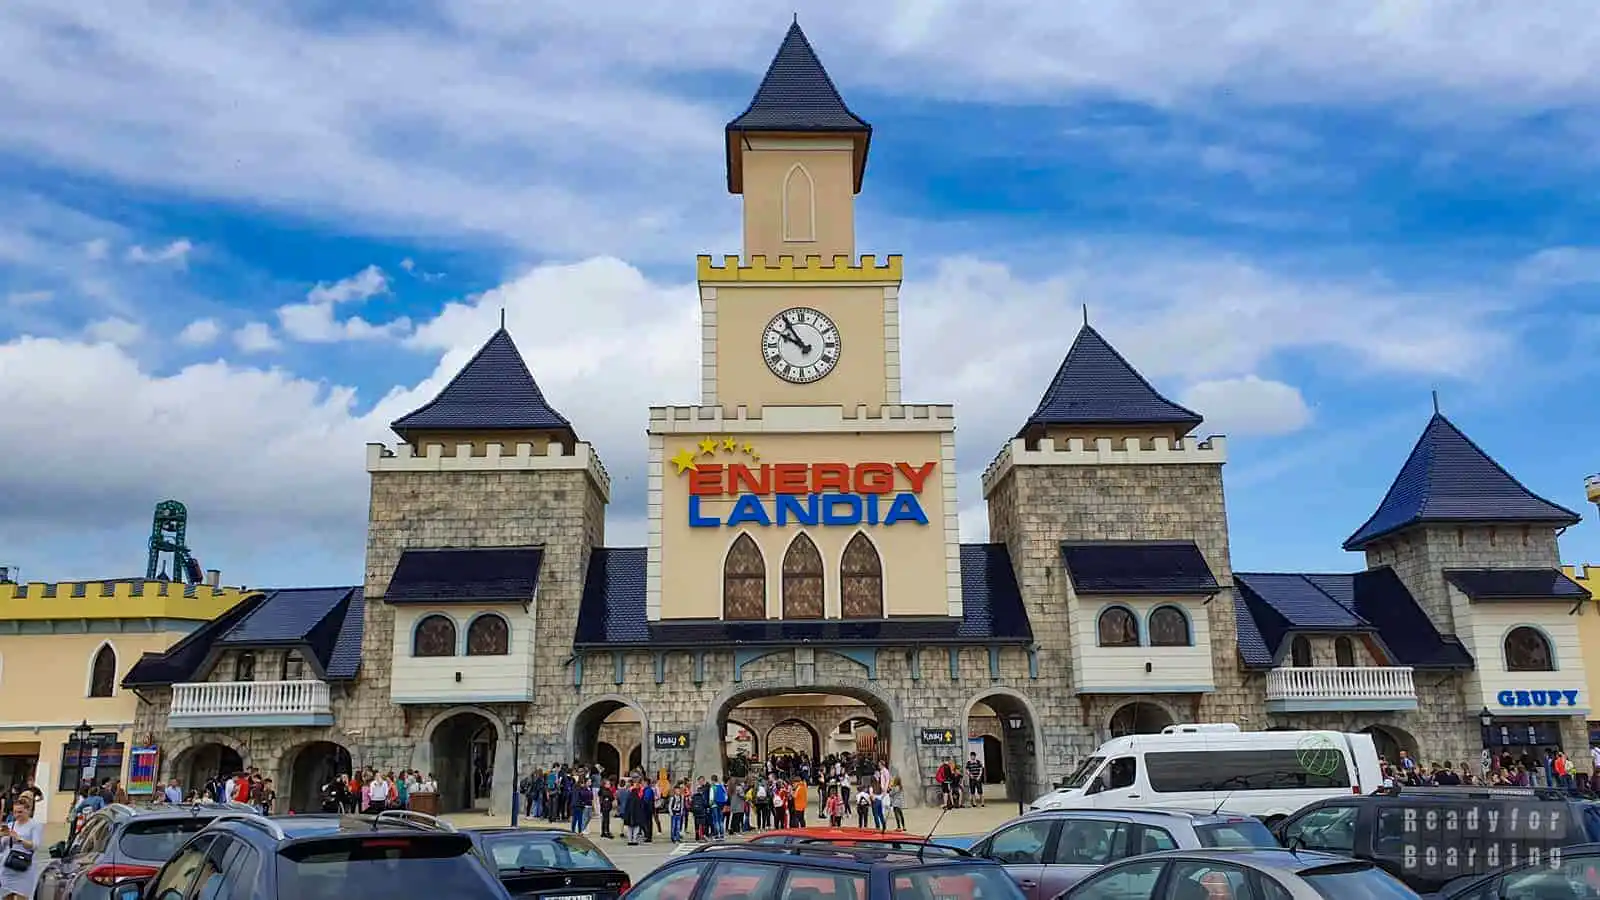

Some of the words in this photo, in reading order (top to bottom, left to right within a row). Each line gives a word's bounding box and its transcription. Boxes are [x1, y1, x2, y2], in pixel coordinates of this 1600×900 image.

[688, 462, 937, 495] ENERGY
[688, 493, 929, 527] LANDIA
[1497, 690, 1578, 706] GRUPY
